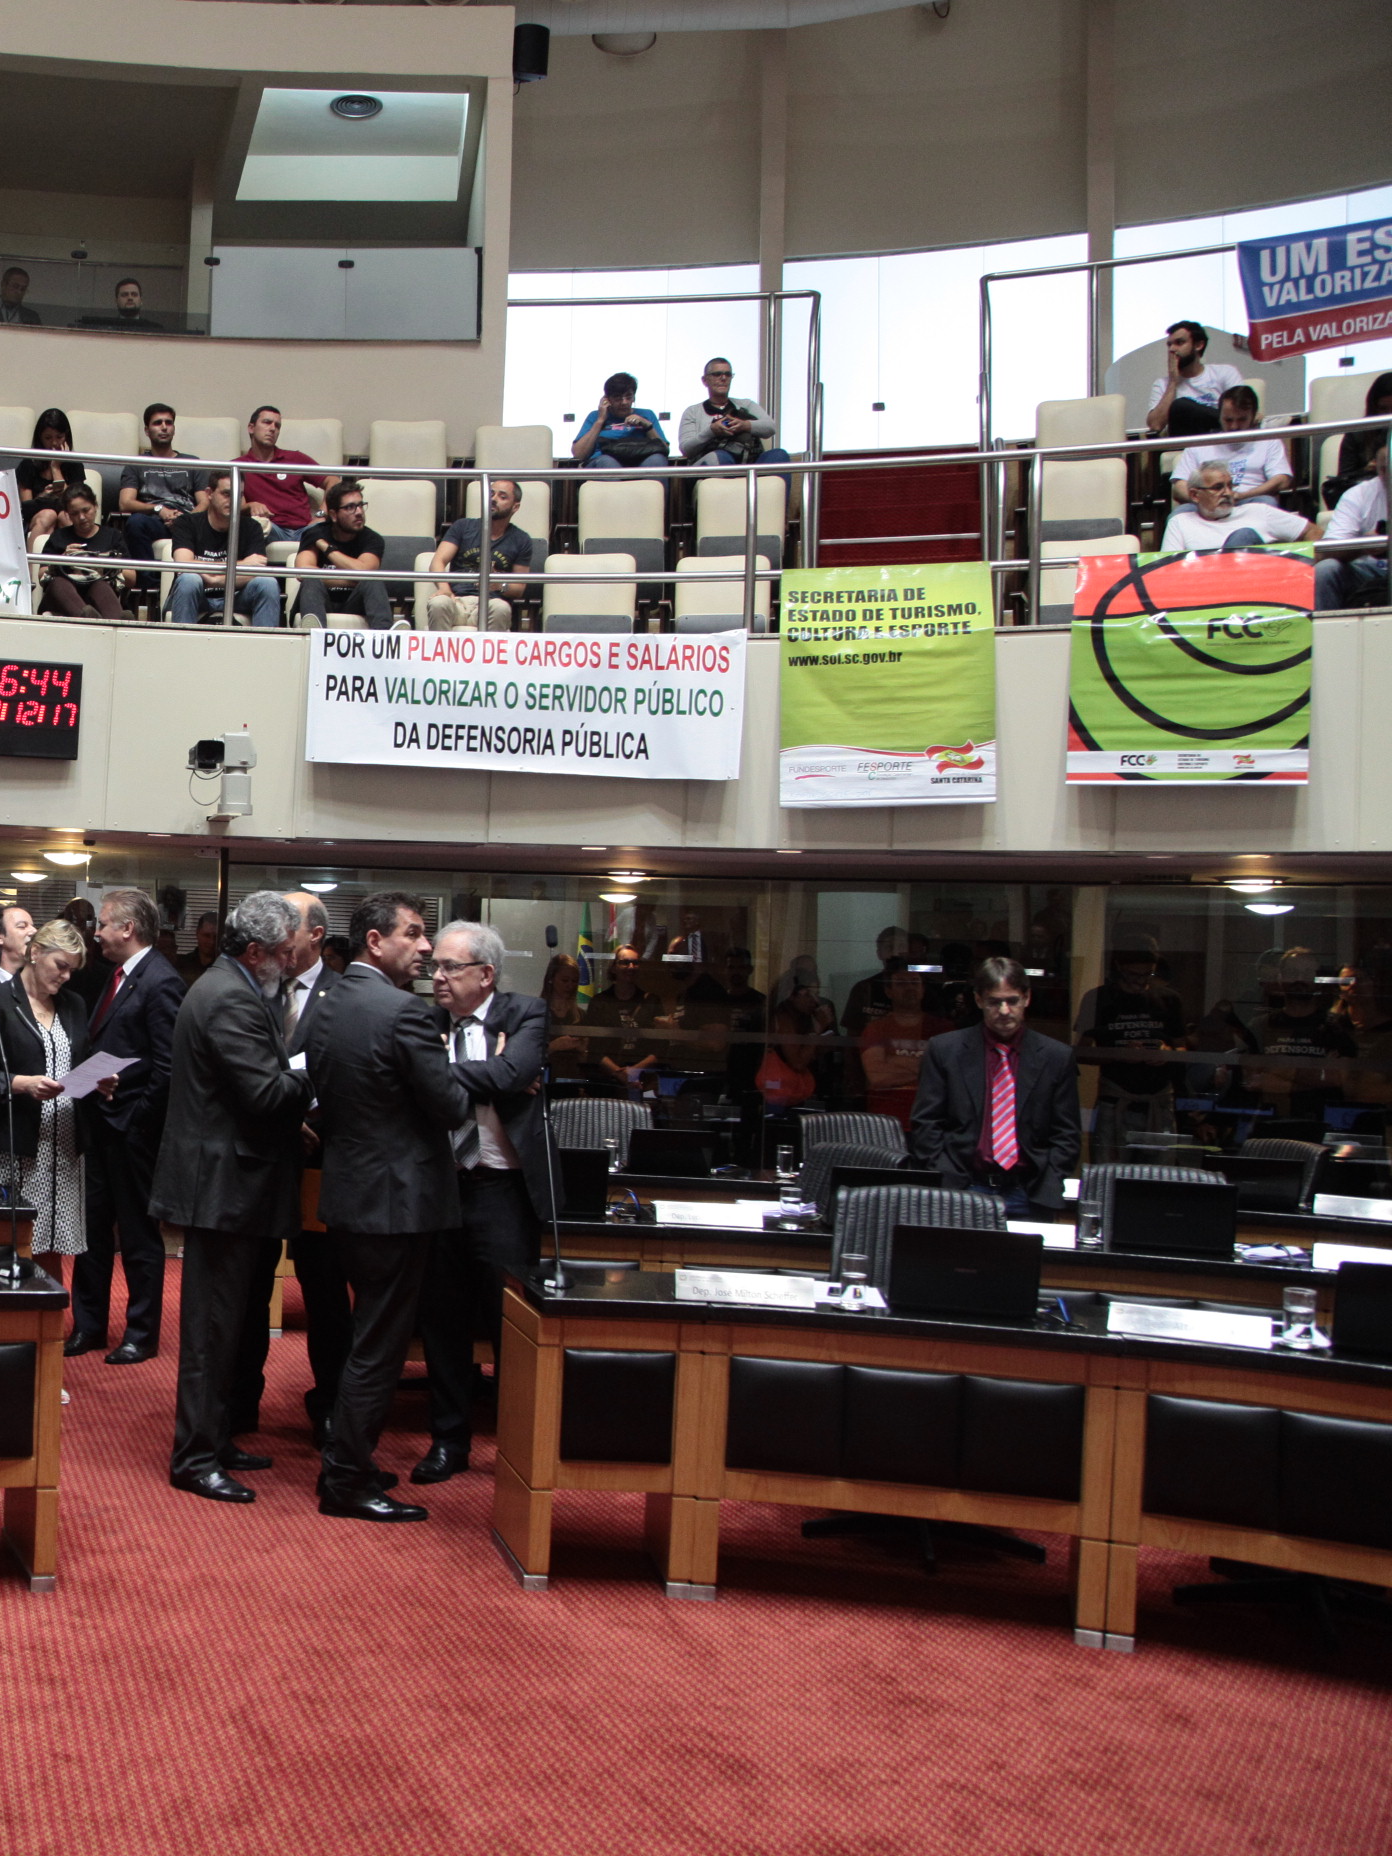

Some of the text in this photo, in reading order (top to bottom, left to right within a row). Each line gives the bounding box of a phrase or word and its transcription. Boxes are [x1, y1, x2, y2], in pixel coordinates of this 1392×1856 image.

[1260, 237, 1328, 284] UM
[1261, 328, 1305, 350] PELA
[788, 587, 926, 604] SECRETARIA DE
[788, 602, 982, 622] ESTADO DE TURISMO,
[787, 620, 973, 643] CULTURA E ESPORTE
[1207, 615, 1264, 639] FCC
[323, 632, 730, 674] POR UM PLANO DE CARGOS E SALÁRIOS
[325, 674, 724, 717] PARA VALORIZAR O SERVIDOR PÚBLICO
[393, 721, 649, 761] DA DEFENSORIA PÚBLICA
[789, 761, 913, 774] FUNDESPORTE FESPORTE
[1120, 755, 1146, 767] FCC
[931, 776, 983, 785] SANTA CATARINA
[693, 1285, 711, 1299] Dep.
[714, 1287, 732, 1298] José
[735, 1289, 762, 1299] Milton
